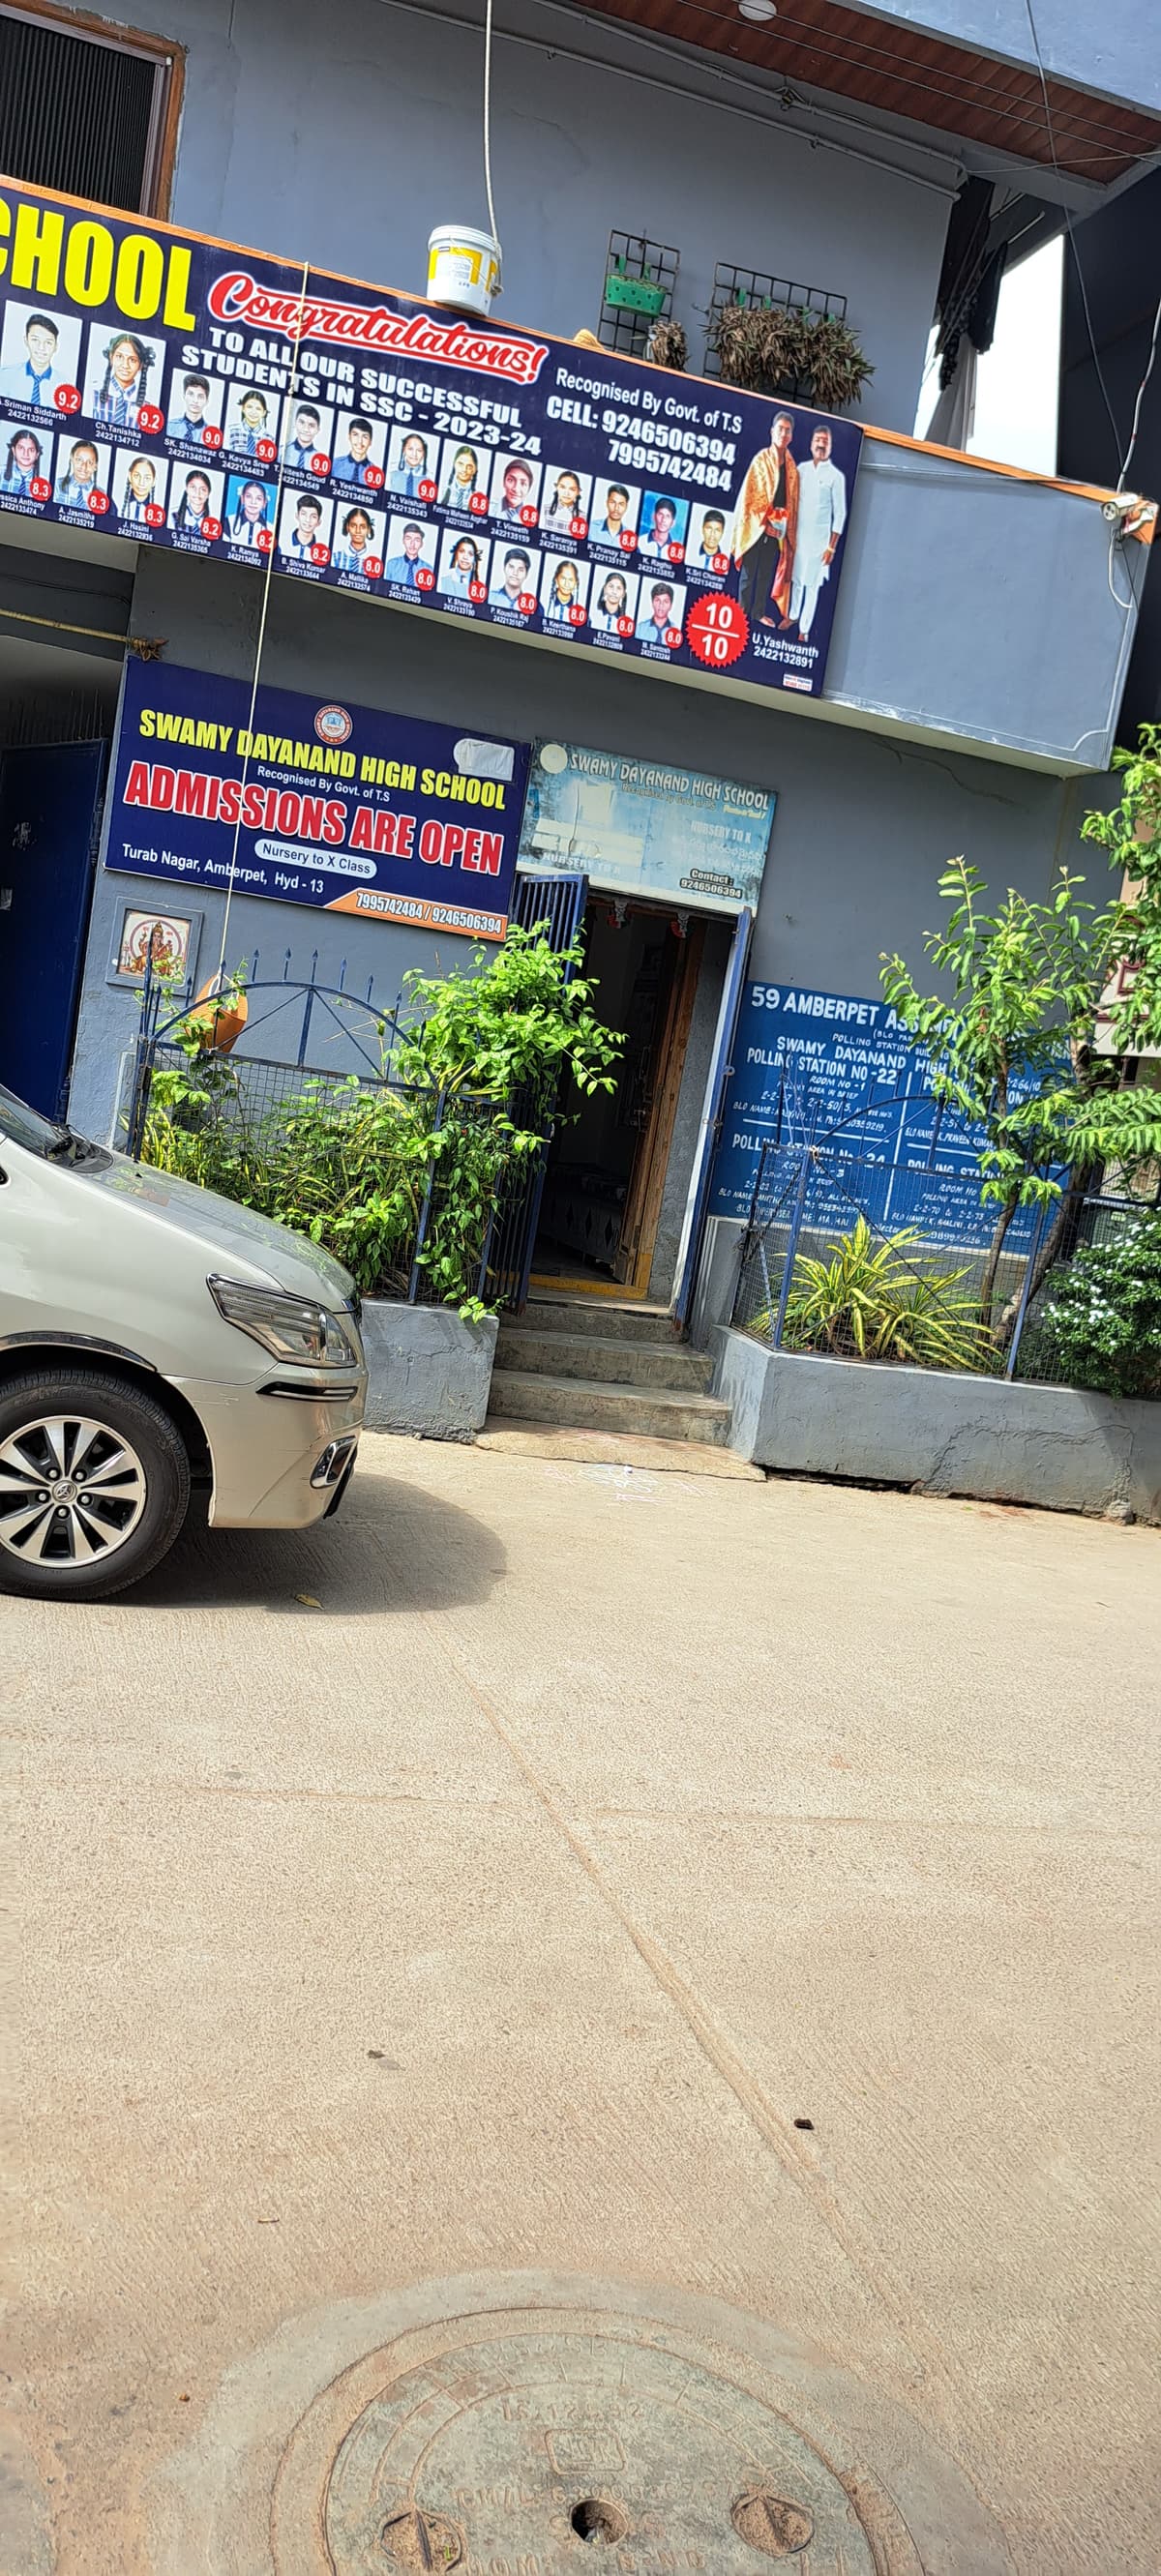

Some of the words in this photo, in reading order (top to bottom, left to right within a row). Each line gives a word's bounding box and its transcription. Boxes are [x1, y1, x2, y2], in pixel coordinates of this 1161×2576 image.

[0, 197, 195, 332] HOOL
[209, 272, 548, 383] Congratulations!
[210, 327, 244, 353] TO
[251, 337, 293, 367] ALL
[300, 349, 354, 383] OUR
[360, 368, 522, 429] SUCCESSFUL
[58, 391, 78, 408] 9.2
[181, 345, 320, 397] STUDENTS
[326, 381, 354, 403] IN
[361, 392, 413, 423] SSC
[433, 410, 542, 458] 2023-24
[556, 368, 640, 406] Recognised
[642, 391, 661, 416] By
[665, 397, 700, 424] Govt.
[704, 408, 720, 427] of
[722, 412, 743, 434] T.S
[140, 411, 160, 430] 9.2
[546, 395, 598, 429] CELL:
[602, 409, 736, 465] 9246506394
[205, 431, 221, 446] 9.0
[258, 445, 275, 459] 9.0
[313, 459, 329, 473] 9.0
[608, 438, 732, 492] 7995742484
[367, 471, 382, 486] 9.0
[32, 483, 48, 497] 8.3
[420, 485, 435, 499] 9.0
[90, 495, 106, 511] 8.3
[471, 497, 486, 511] 8.8
[147, 509, 163, 523] 8.3
[522, 510, 537, 523] 8.8
[202, 522, 219, 536] 8.2
[572, 522, 586, 535] 8.8
[621, 535, 636, 548] 8.8
[313, 548, 328, 563] 8.2
[670, 548, 684, 560] 8.8
[365, 561, 381, 575] 8.0
[714, 558, 728, 571] 8.8
[418, 574, 432, 586] 8.0
[471, 585, 485, 598] 8.0
[521, 597, 535, 609] 8.0
[571, 609, 585, 621] 8.0
[706, 603, 732, 629] 10
[618, 620, 633, 633] 8.0
[668, 632, 681, 644] 8.0
[752, 633, 819, 659] U.Yashwanth
[702, 634, 729, 660] 10
[753, 645, 814, 669] 2422132891
[139, 709, 233, 754] SWAMY
[236, 728, 356, 779] DAYANAND
[360, 755, 417, 792] HIGH
[421, 771, 505, 811] SCHOOL
[257, 765, 316, 789] Recognised
[319, 777, 332, 793] By
[334, 780, 360, 798] Govt.
[363, 785, 374, 799] of
[375, 788, 391, 803] T.S
[570, 754, 618, 780] SWAMY
[619, 765, 690, 793] DAYANAND
[692, 779, 721, 800] HIGH
[724, 786, 769, 811] SCHOOL
[124, 760, 348, 845] ADMISSIONS
[349, 805, 417, 860] ARE
[419, 820, 504, 877] OPEN
[262, 844, 310, 868] Nursery
[313, 852, 325, 866] to
[327, 854, 336, 868] X
[339, 856, 372, 874] Class
[122, 844, 159, 863] Turab
[161, 850, 201, 873] Nagar,
[203, 859, 268, 886] Amberpet,
[275, 871, 298, 892] Hyd
[310, 879, 324, 894] 13
[680, 878, 742, 899] 9246506394
[357, 892, 424, 921] 7995742484
[431, 906, 501, 934] 9246506394
[751, 986, 780, 1009] 59
[783, 992, 879, 1026] AMBERPET
[832, 1033, 871, 1047] POLLING
[777, 1036, 826, 1056] SWAMY
[834, 1046, 907, 1069] DAYANAND
[915, 1059, 947, 1076] HIGH
[798, 1056, 846, 1077] STATION
[850, 1066, 868, 1081] NO
[810, 1076, 836, 1087] ROOM
[908, 1159, 955, 1179] POLING
